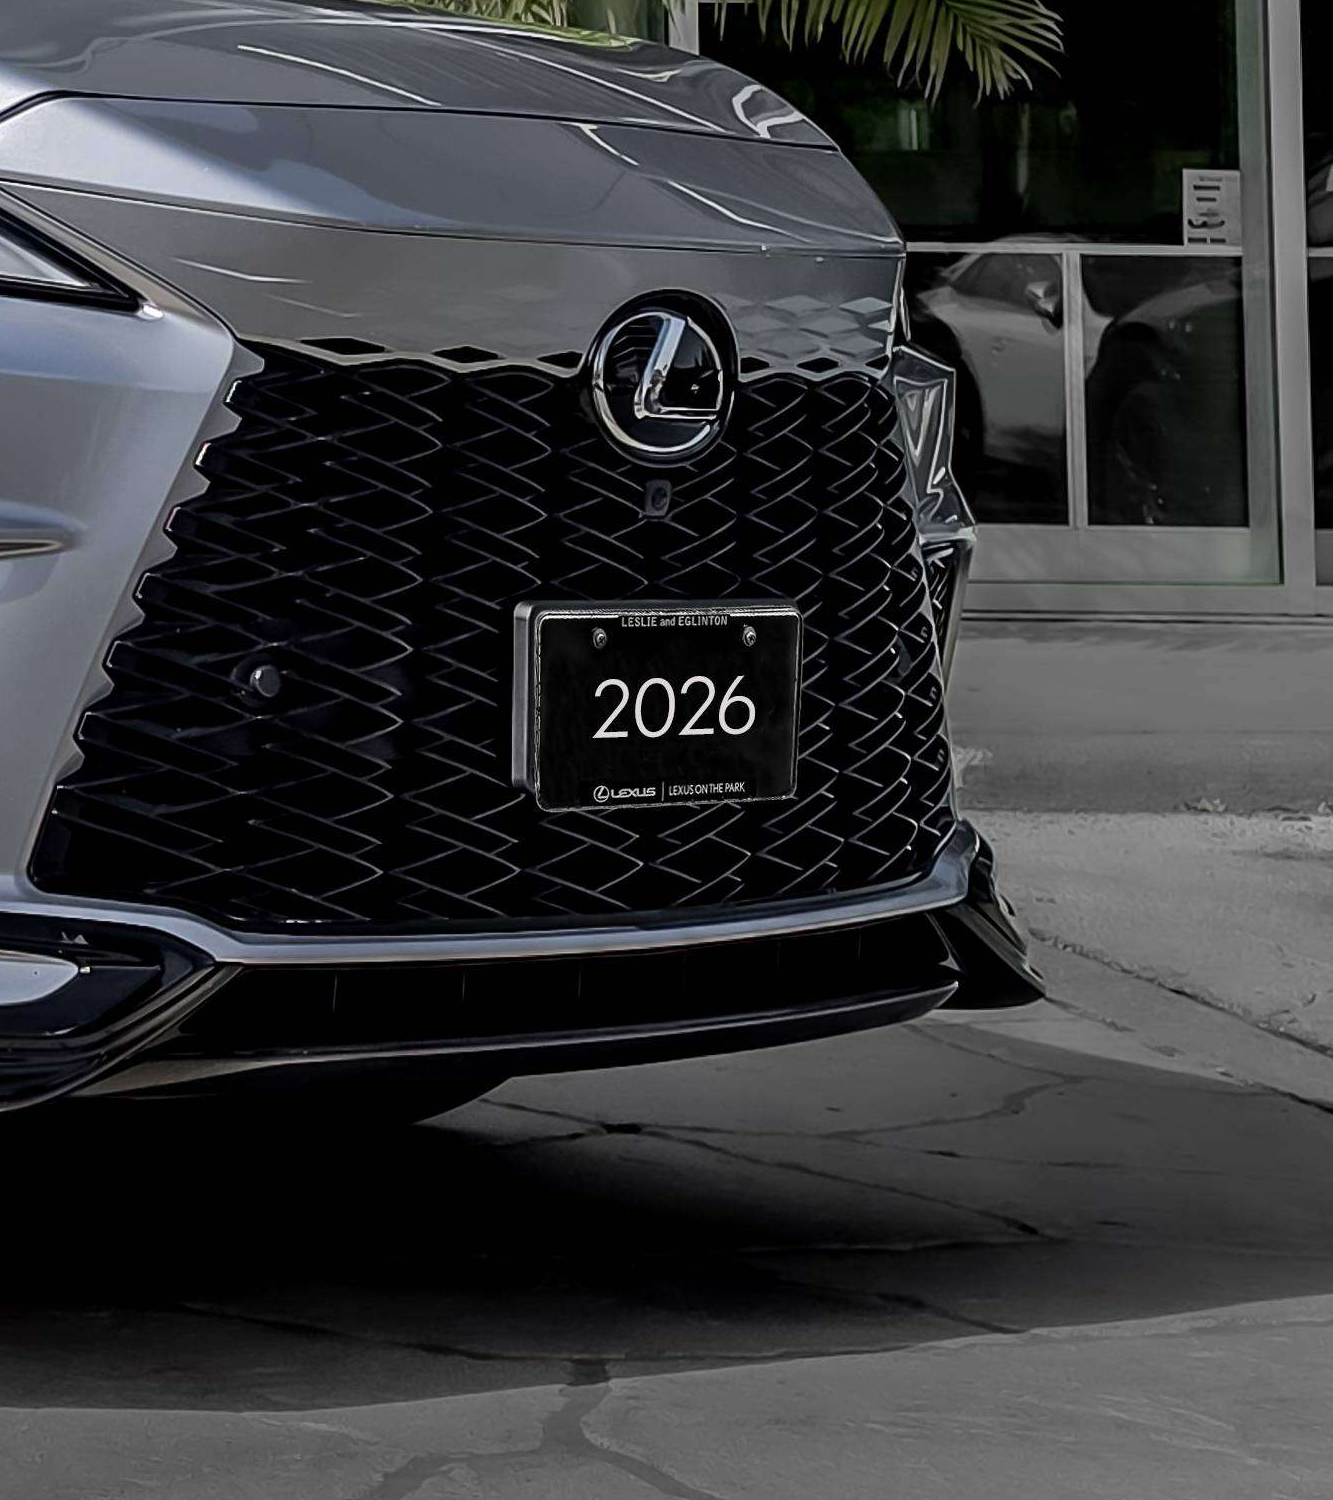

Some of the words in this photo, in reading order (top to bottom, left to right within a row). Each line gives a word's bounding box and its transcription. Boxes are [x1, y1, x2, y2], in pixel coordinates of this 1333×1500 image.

[620, 615, 658, 628] LESLIE
[659, 615, 676, 627] and
[678, 614, 728, 627] EGLINTON
[592, 675, 756, 739] 2026
[610, 786, 657, 799] LEXUS
[668, 783, 694, 797] LEXUS
[694, 783, 708, 796] ON
[708, 782, 724, 795] THE
[724, 781, 746, 794] PARK
